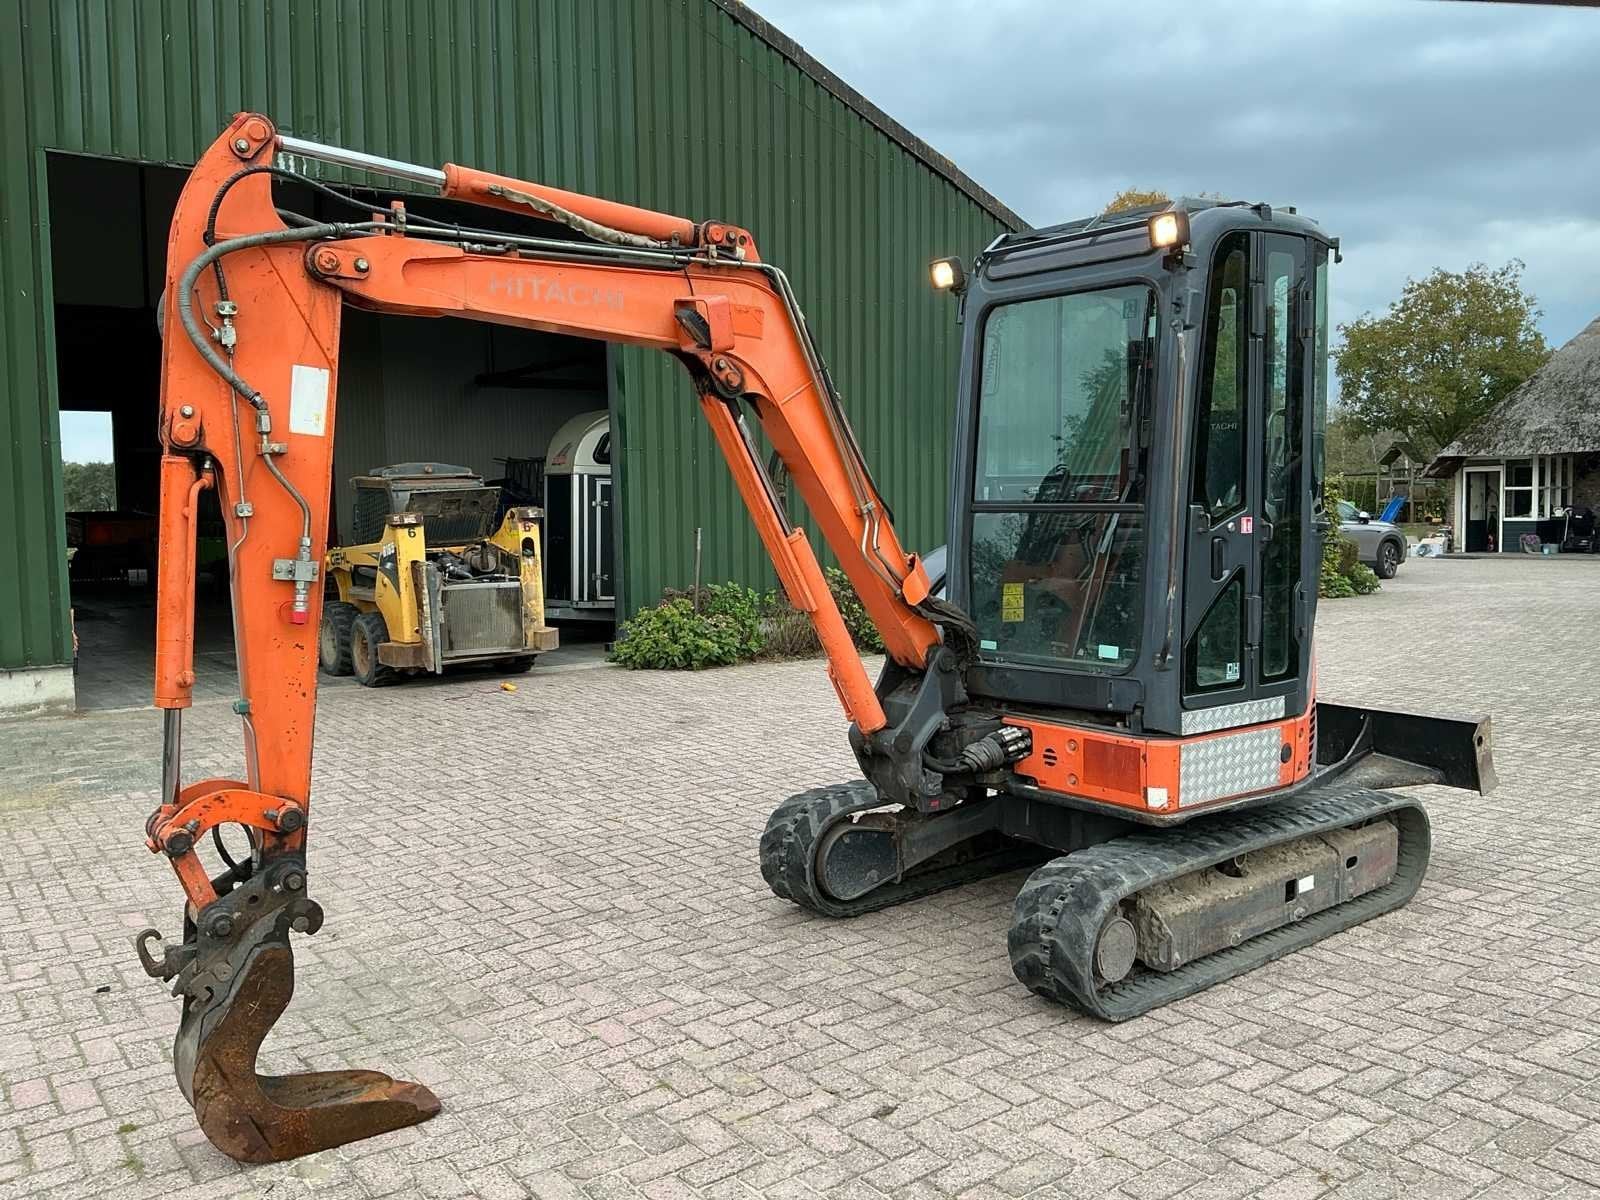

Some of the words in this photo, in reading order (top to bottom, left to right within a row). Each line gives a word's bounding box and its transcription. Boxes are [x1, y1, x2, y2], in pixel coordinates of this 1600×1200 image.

[488, 273, 625, 310] HITACHI
[1210, 422, 1238, 431] TACHI
[407, 527, 417, 538] 6
[331, 551, 351, 566] GEHL
